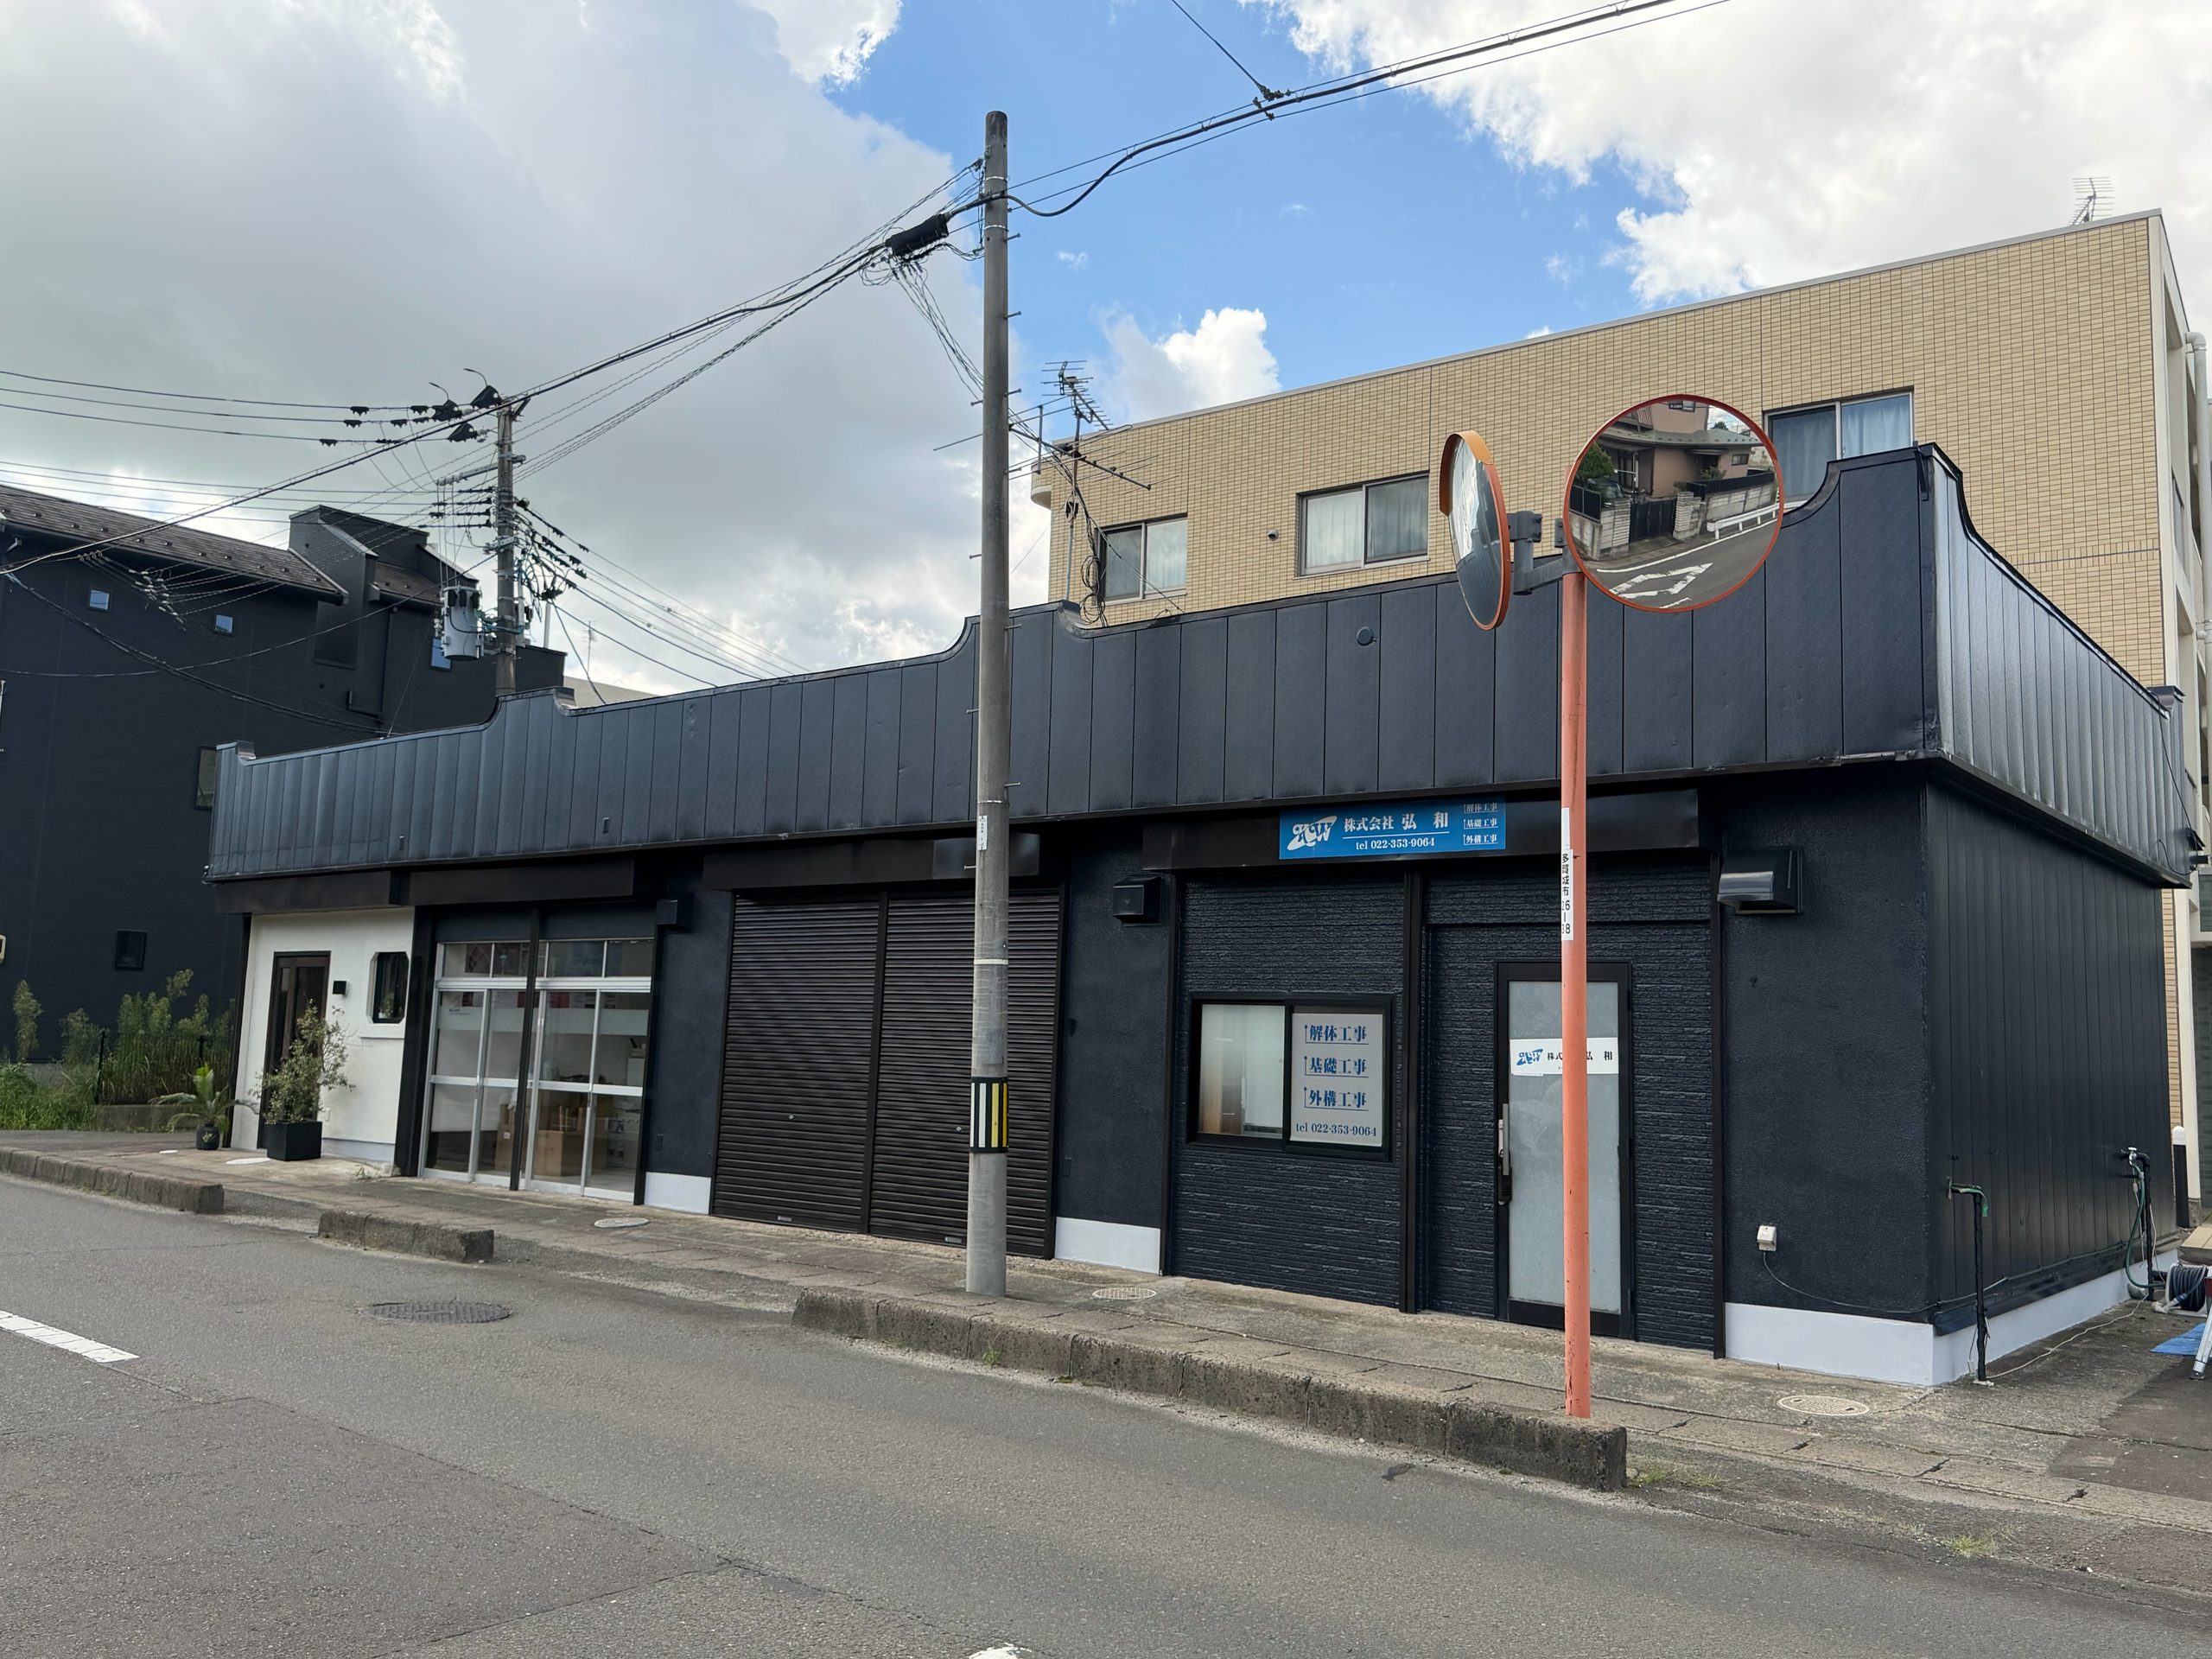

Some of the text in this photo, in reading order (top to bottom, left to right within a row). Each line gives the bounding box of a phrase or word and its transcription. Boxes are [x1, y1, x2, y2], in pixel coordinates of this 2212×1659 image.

[1344, 817, 1395, 832] 株式会社
[1466, 817, 1497, 828] 基礎工事
[1356, 836, 1435, 850] tel 022-353-9064
[1466, 834, 1497, 844] 外構工事
[1309, 1025, 1367, 1042] 解体工事
[1309, 1057, 1367, 1075] 基礎工事
[1308, 1090, 1367, 1109] 外構工事
[1296, 1122, 1376, 1137] tel 022-353-9064
